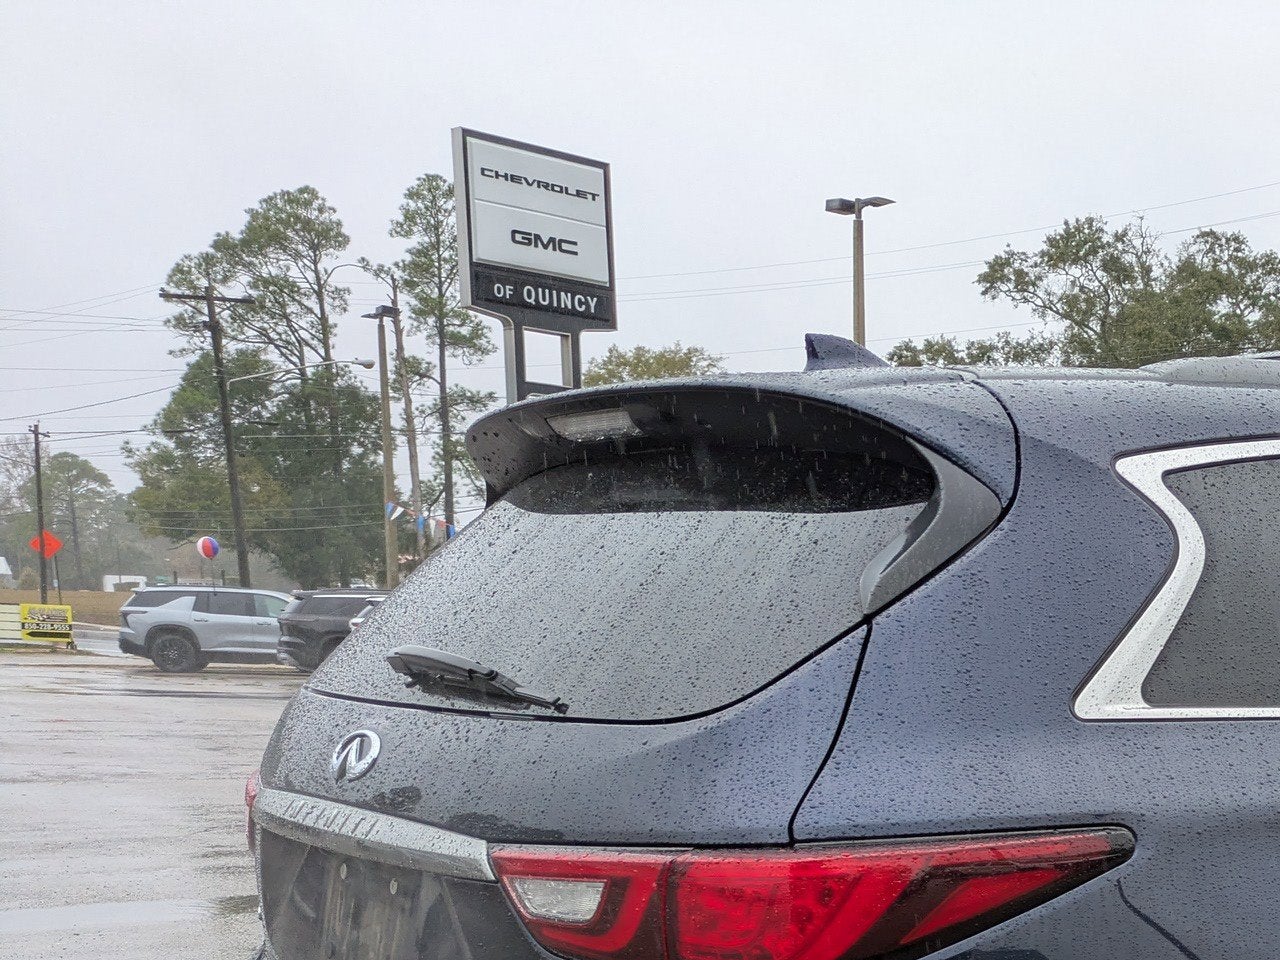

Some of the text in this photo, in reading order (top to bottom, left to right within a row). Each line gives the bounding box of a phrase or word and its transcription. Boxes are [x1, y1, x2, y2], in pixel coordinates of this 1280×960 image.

[480, 167, 600, 202] CHEVROLET
[511, 229, 579, 256] GMC
[493, 283, 598, 313] OF QUINCY
